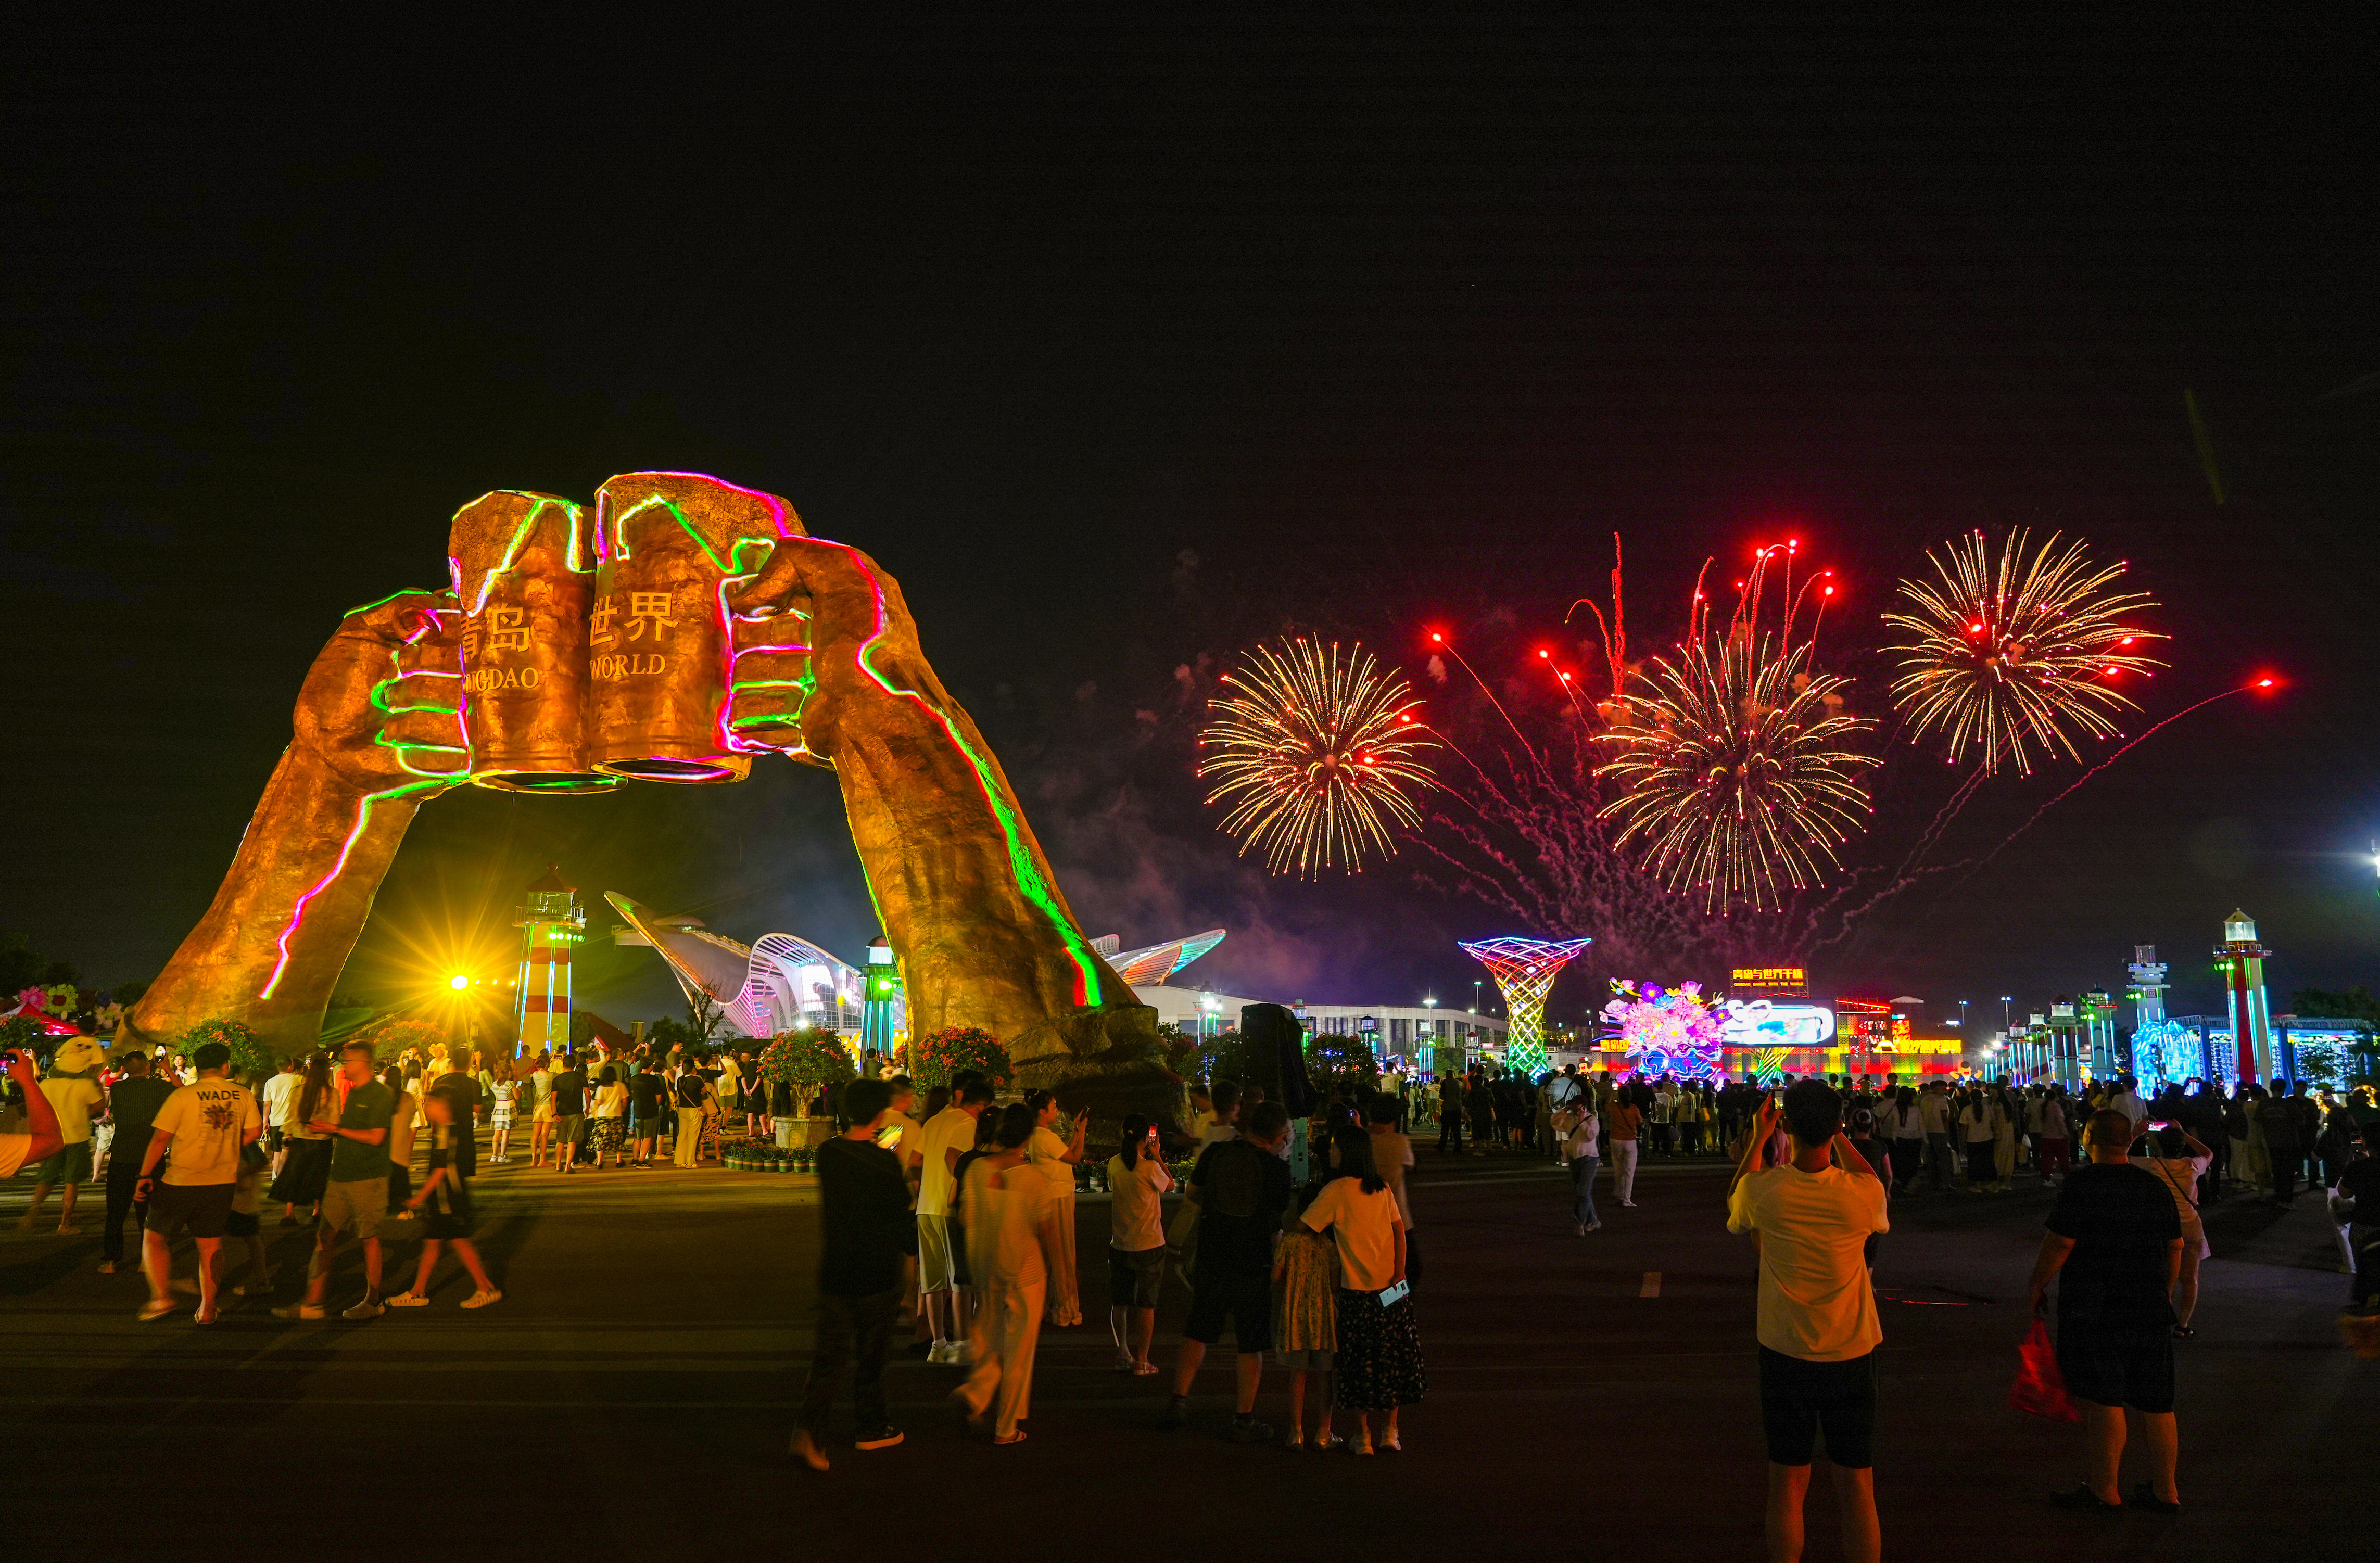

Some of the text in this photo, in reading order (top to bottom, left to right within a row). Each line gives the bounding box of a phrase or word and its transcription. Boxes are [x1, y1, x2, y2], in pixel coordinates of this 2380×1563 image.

[589, 592, 680, 647] 世界
[461, 603, 530, 664] 青岛
[589, 654, 666, 680] WORLD
[1732, 968, 1803, 979] 青岛与世界干杯
[196, 1090, 240, 1101] WADE
